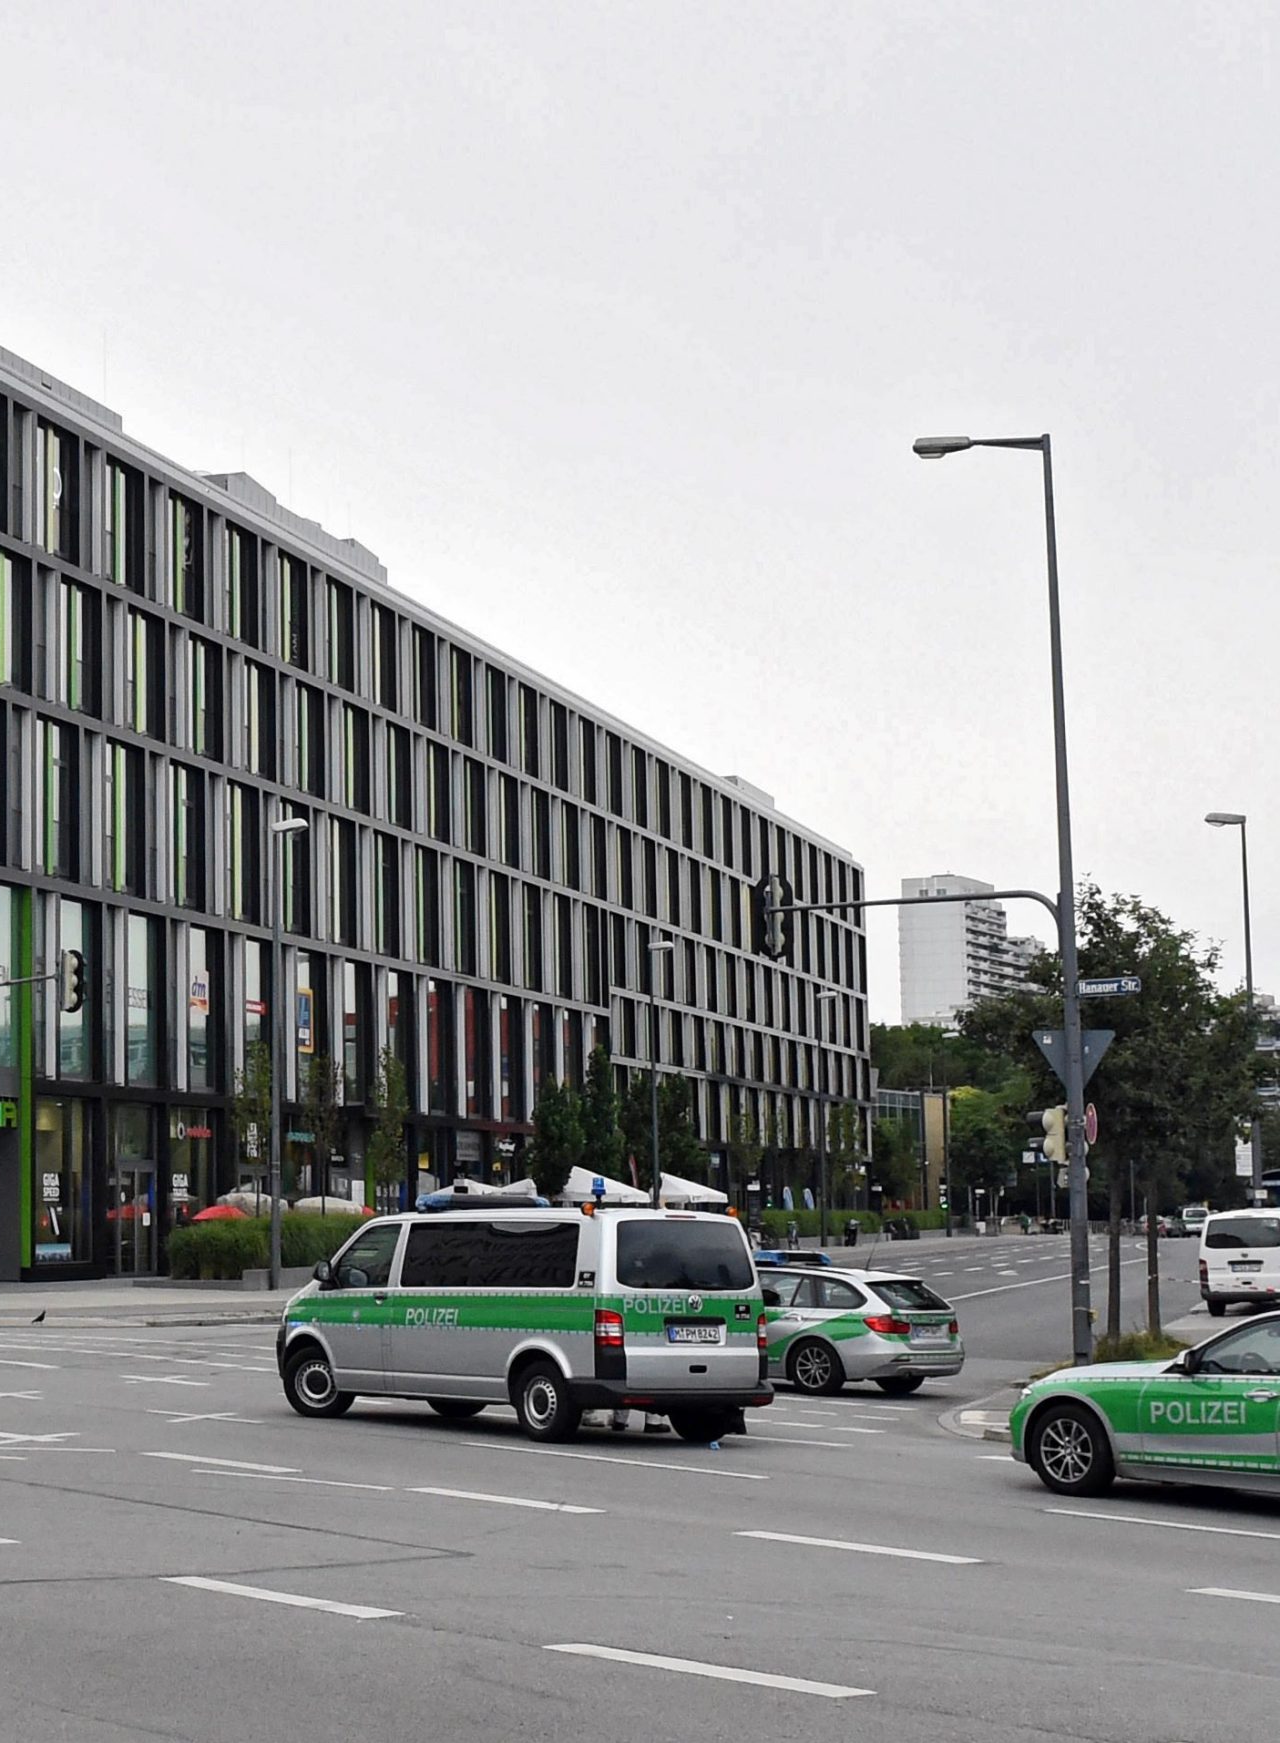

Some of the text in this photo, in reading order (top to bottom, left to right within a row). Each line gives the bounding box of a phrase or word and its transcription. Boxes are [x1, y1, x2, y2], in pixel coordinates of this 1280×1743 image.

[191, 975, 206, 998] dm
[1079, 979, 1139, 994] Hanauer Str.
[623, 1298, 687, 1314] POLIZEI
[405, 1307, 459, 1326] POLIZEI
[1150, 1401, 1247, 1424] POLIZEI
